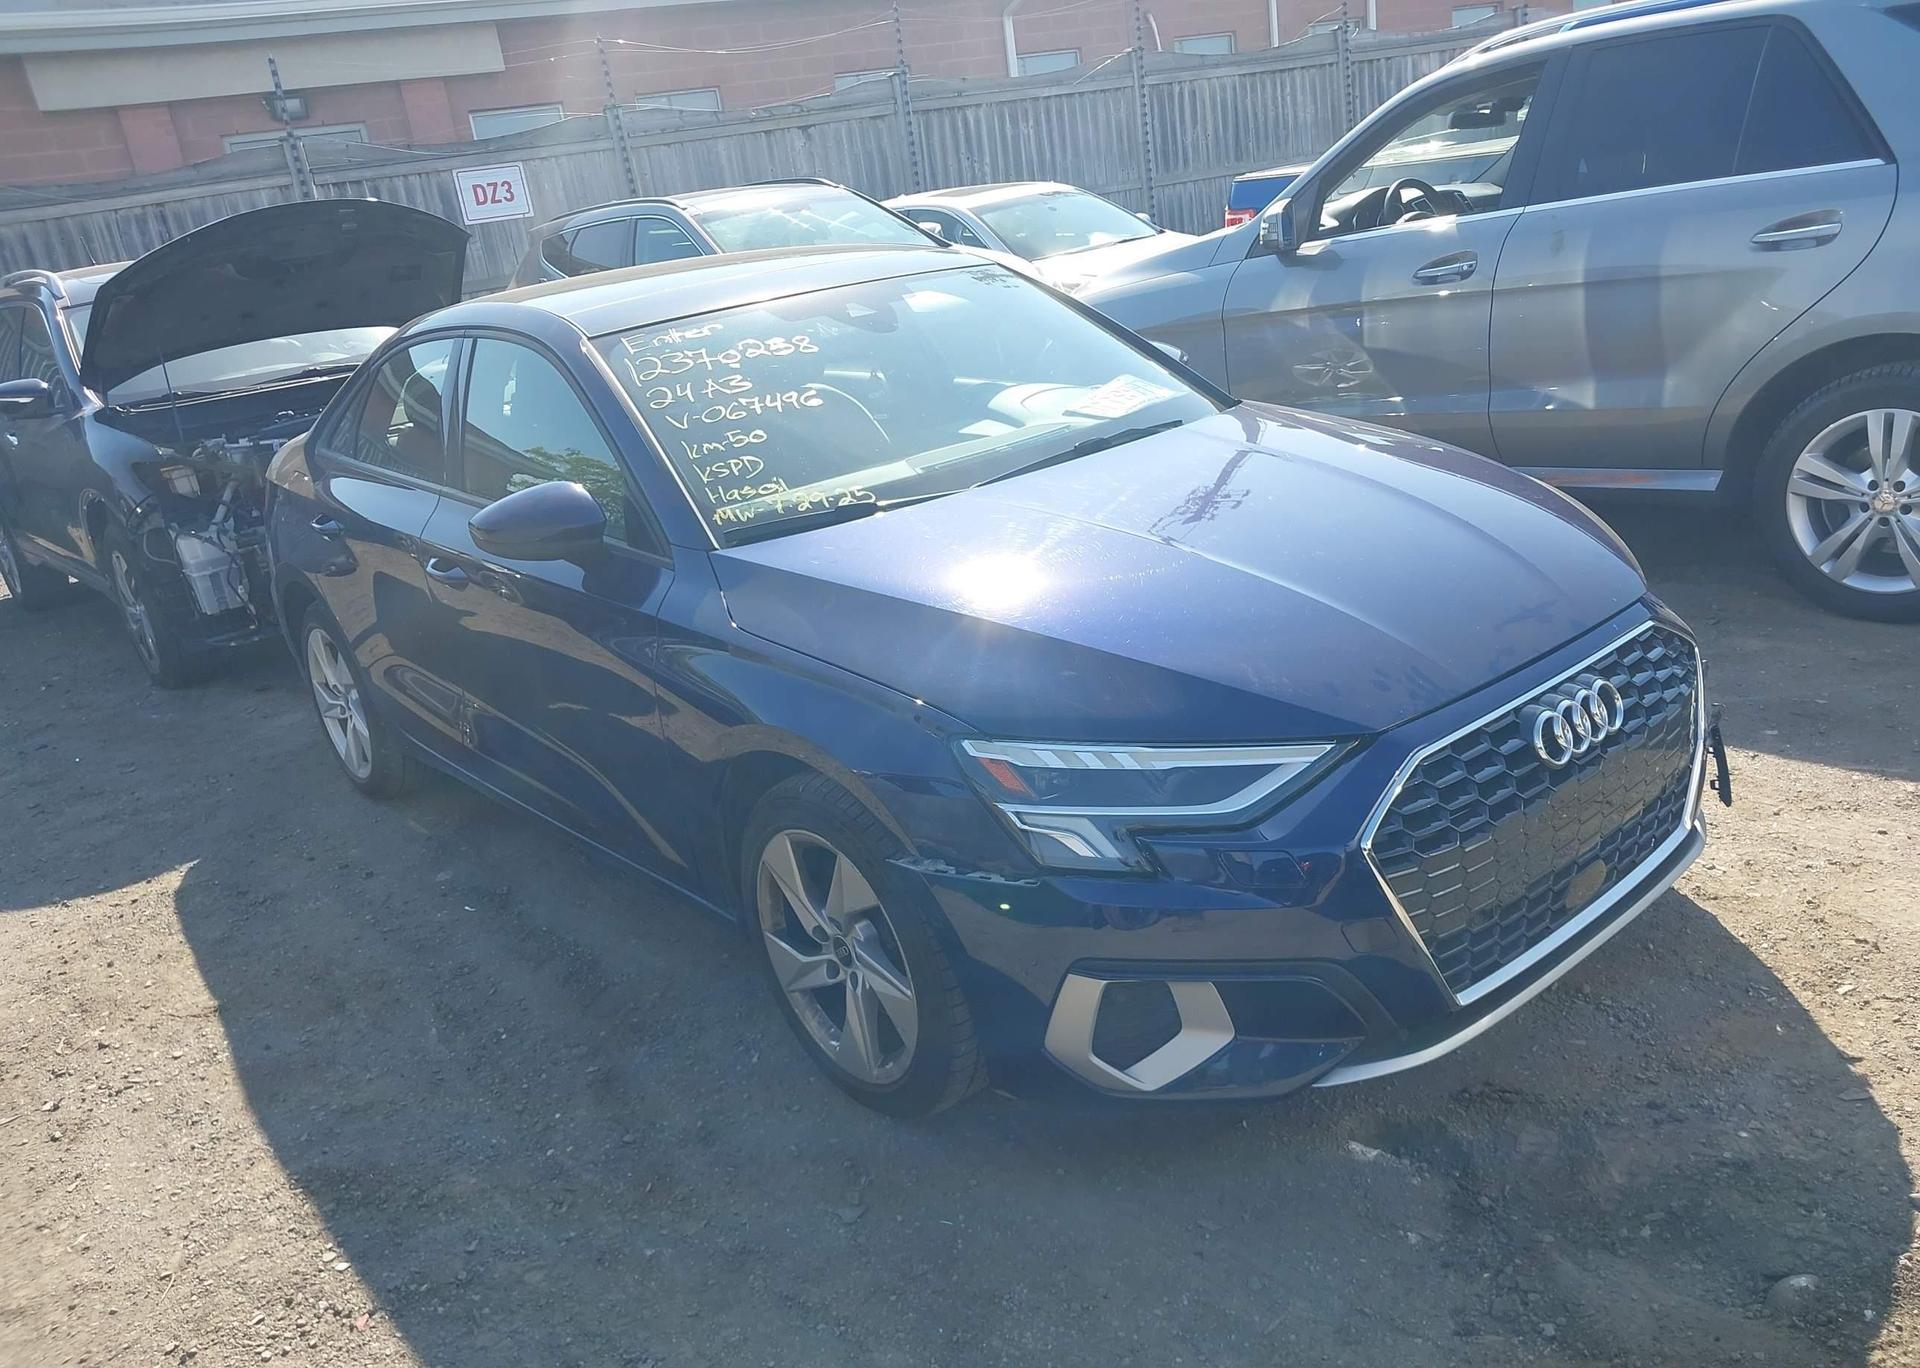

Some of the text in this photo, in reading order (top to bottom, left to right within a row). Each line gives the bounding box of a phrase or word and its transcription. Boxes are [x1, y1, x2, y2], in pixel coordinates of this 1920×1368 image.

[471, 180, 515, 206] DZ3
[646, 374, 753, 410] 24 A3
